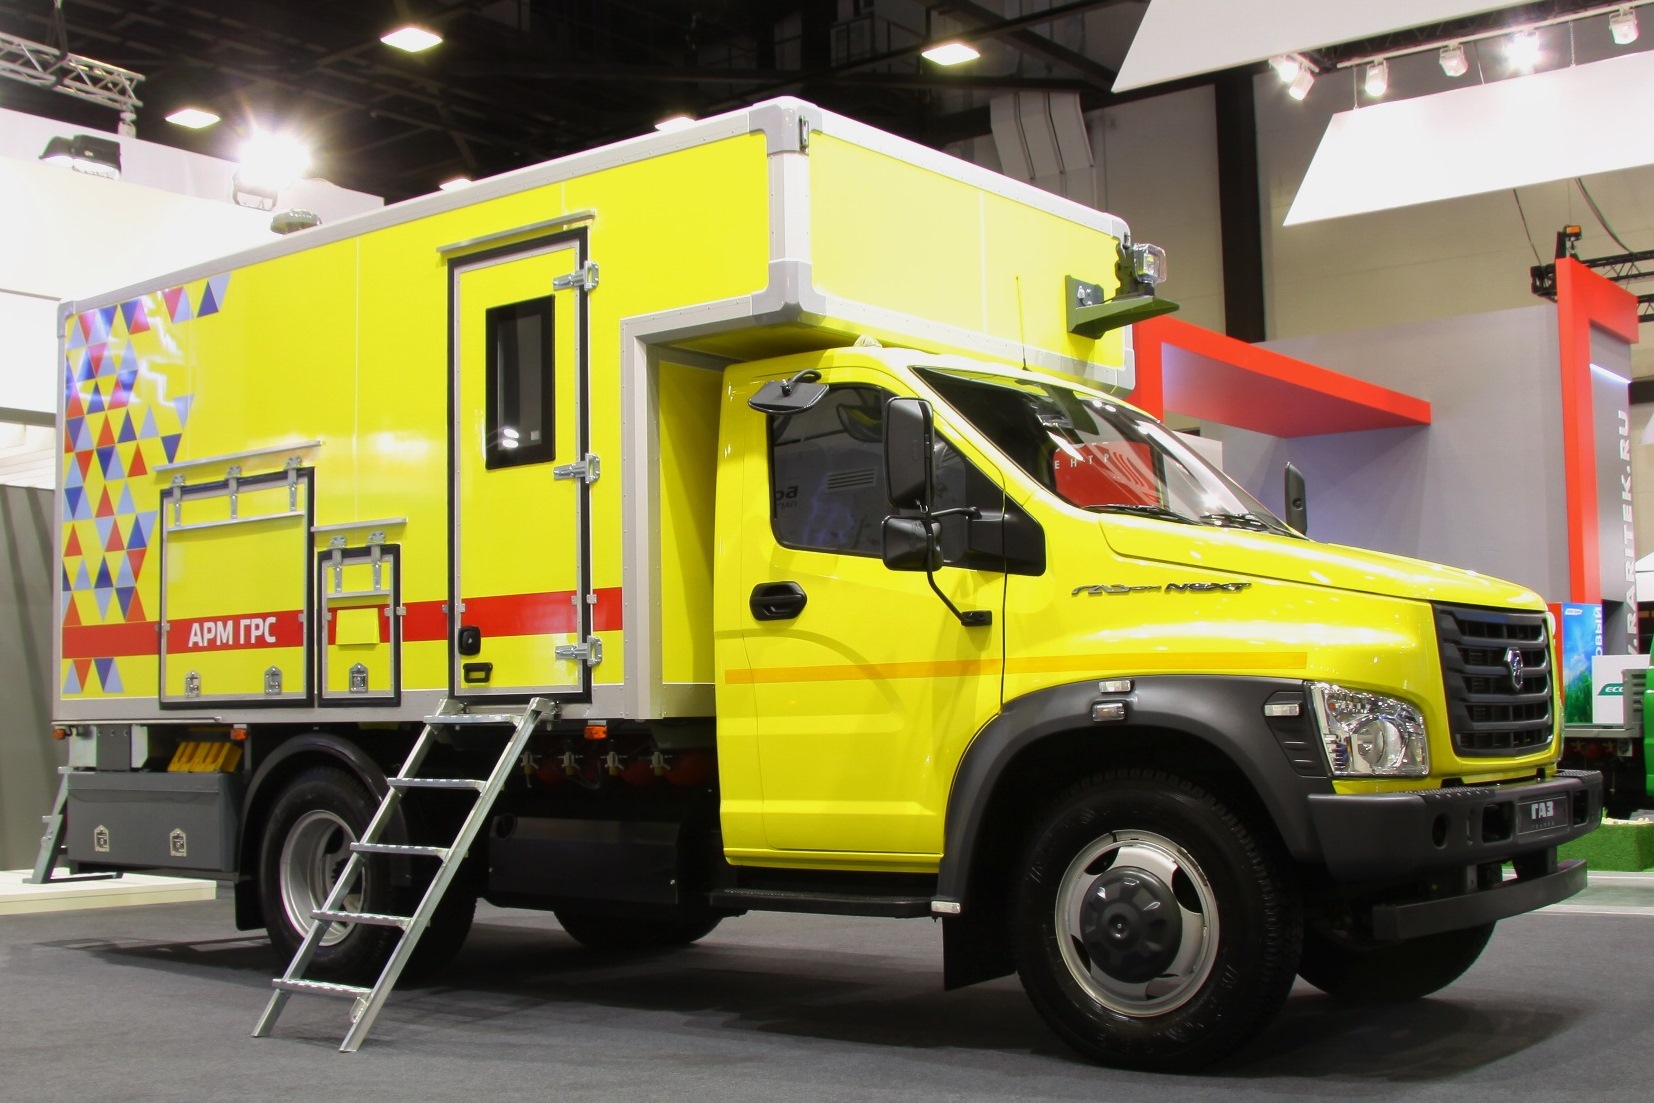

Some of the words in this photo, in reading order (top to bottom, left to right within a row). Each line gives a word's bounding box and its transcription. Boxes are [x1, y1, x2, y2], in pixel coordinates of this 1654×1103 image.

[1164, 582, 1252, 594] NEXT
[188, 620, 234, 648] АРМ
[239, 616, 277, 645] ГРС
[1531, 801, 1554, 820] ГАЗ
